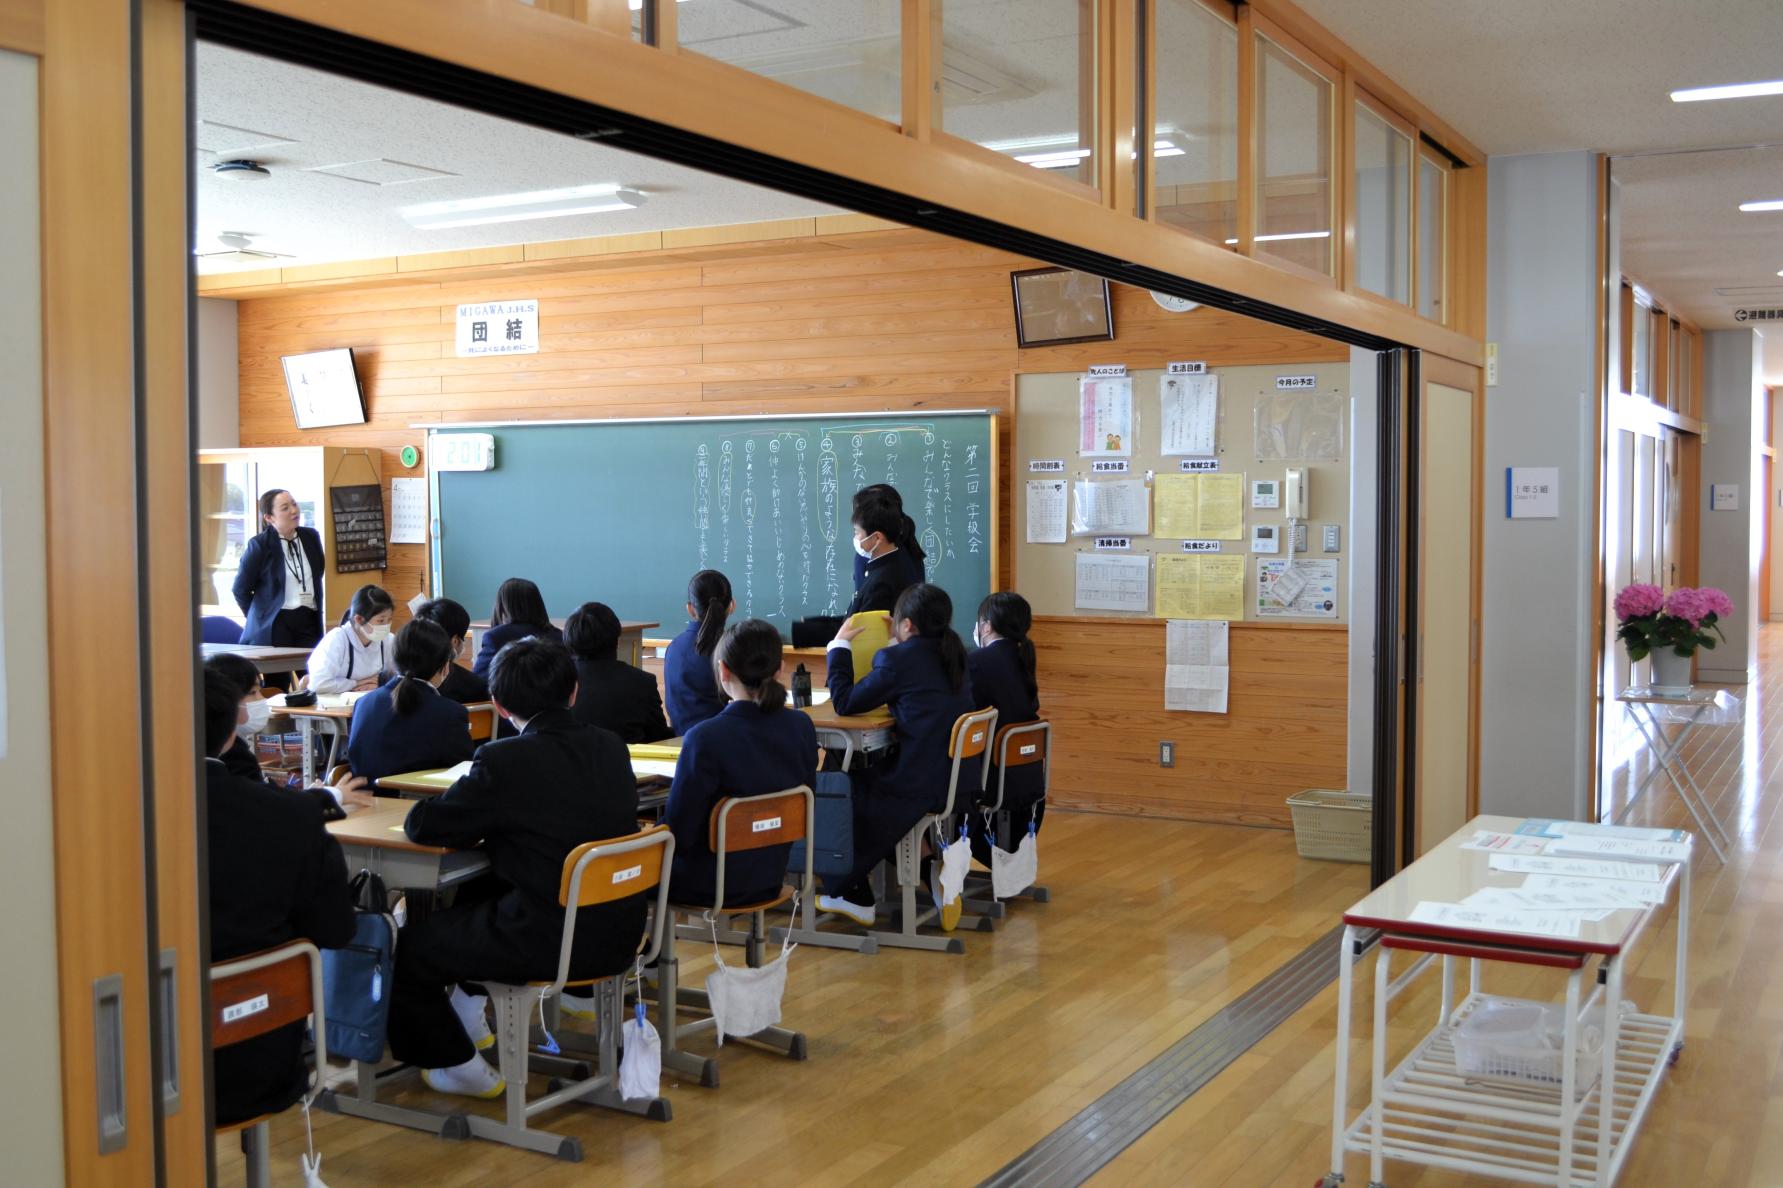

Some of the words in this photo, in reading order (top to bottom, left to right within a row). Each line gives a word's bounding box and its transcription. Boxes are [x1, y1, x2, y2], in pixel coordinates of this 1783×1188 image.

[460, 304, 504, 317] MIGAWA
[1278, 378, 1314, 387] 今月の予定
[1096, 461, 1125, 471] 給食当番
[1184, 542, 1218, 550] 給食だより
